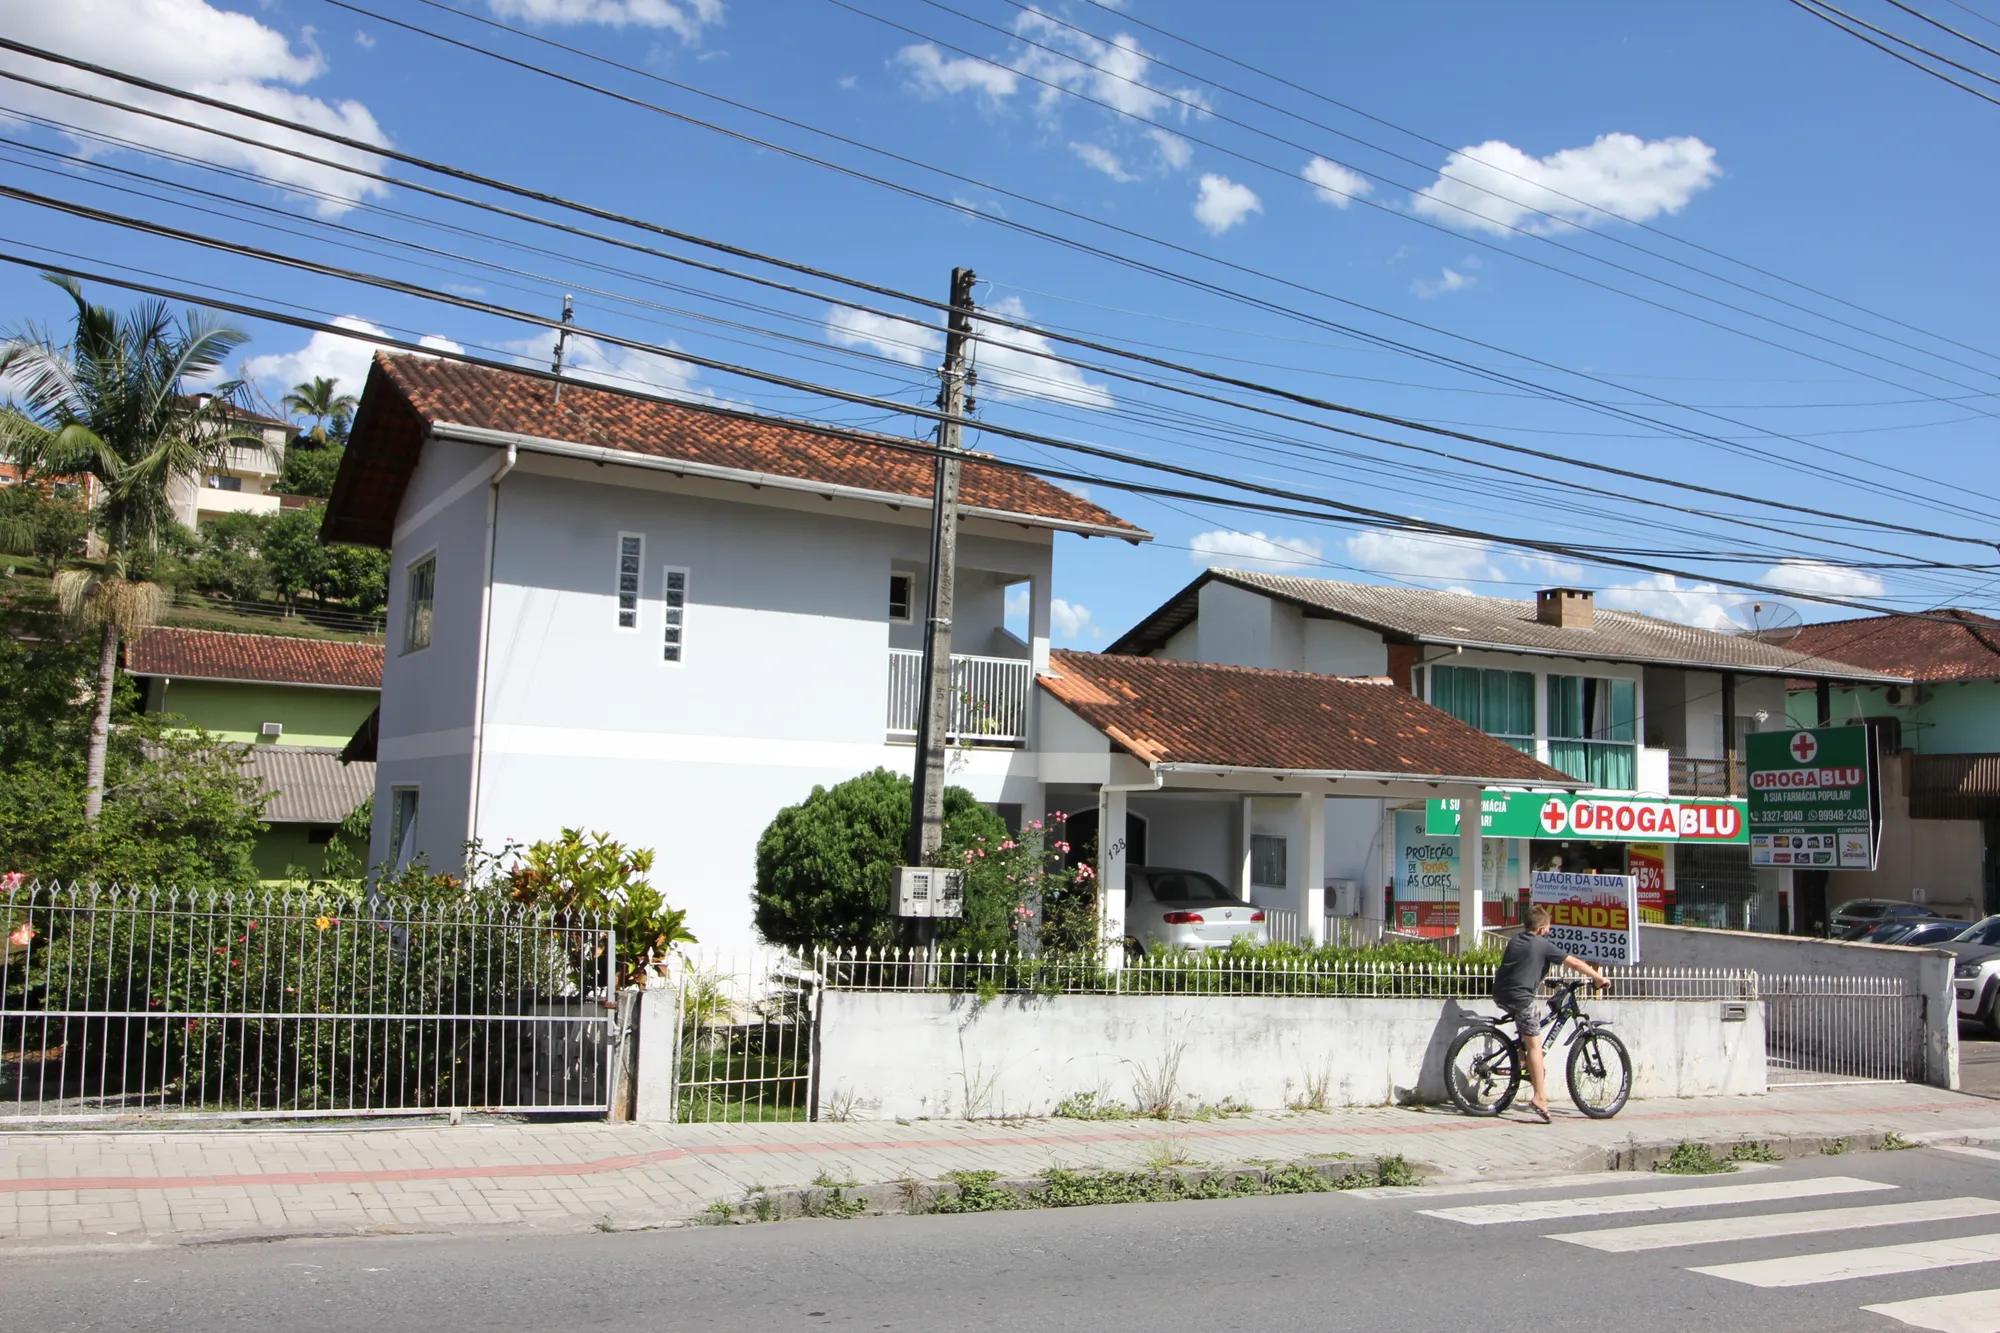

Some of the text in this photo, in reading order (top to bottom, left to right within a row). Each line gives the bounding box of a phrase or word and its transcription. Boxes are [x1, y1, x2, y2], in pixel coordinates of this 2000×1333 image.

[1753, 768, 1860, 788] DROGABLU
[1764, 789, 1851, 802] A SUA FARMÁCIA POPULAR!
[1441, 799, 1447, 810] A
[1449, 799, 1460, 811] SU
[1575, 804, 1735, 835] DROGABLU
[1761, 809, 1868, 821] 3327-0040 99948-2430
[1108, 837, 1126, 861] 128
[1405, 844, 1454, 862] PROTEÇÃO
[1420, 861, 1449, 873] TODAS
[1407, 874, 1452, 888] AS CORES
[1536, 873, 1624, 887] ALAOR DA SILVA
[1536, 904, 1627, 929] VENDE
[1549, 927, 1627, 946] 3328-5556
